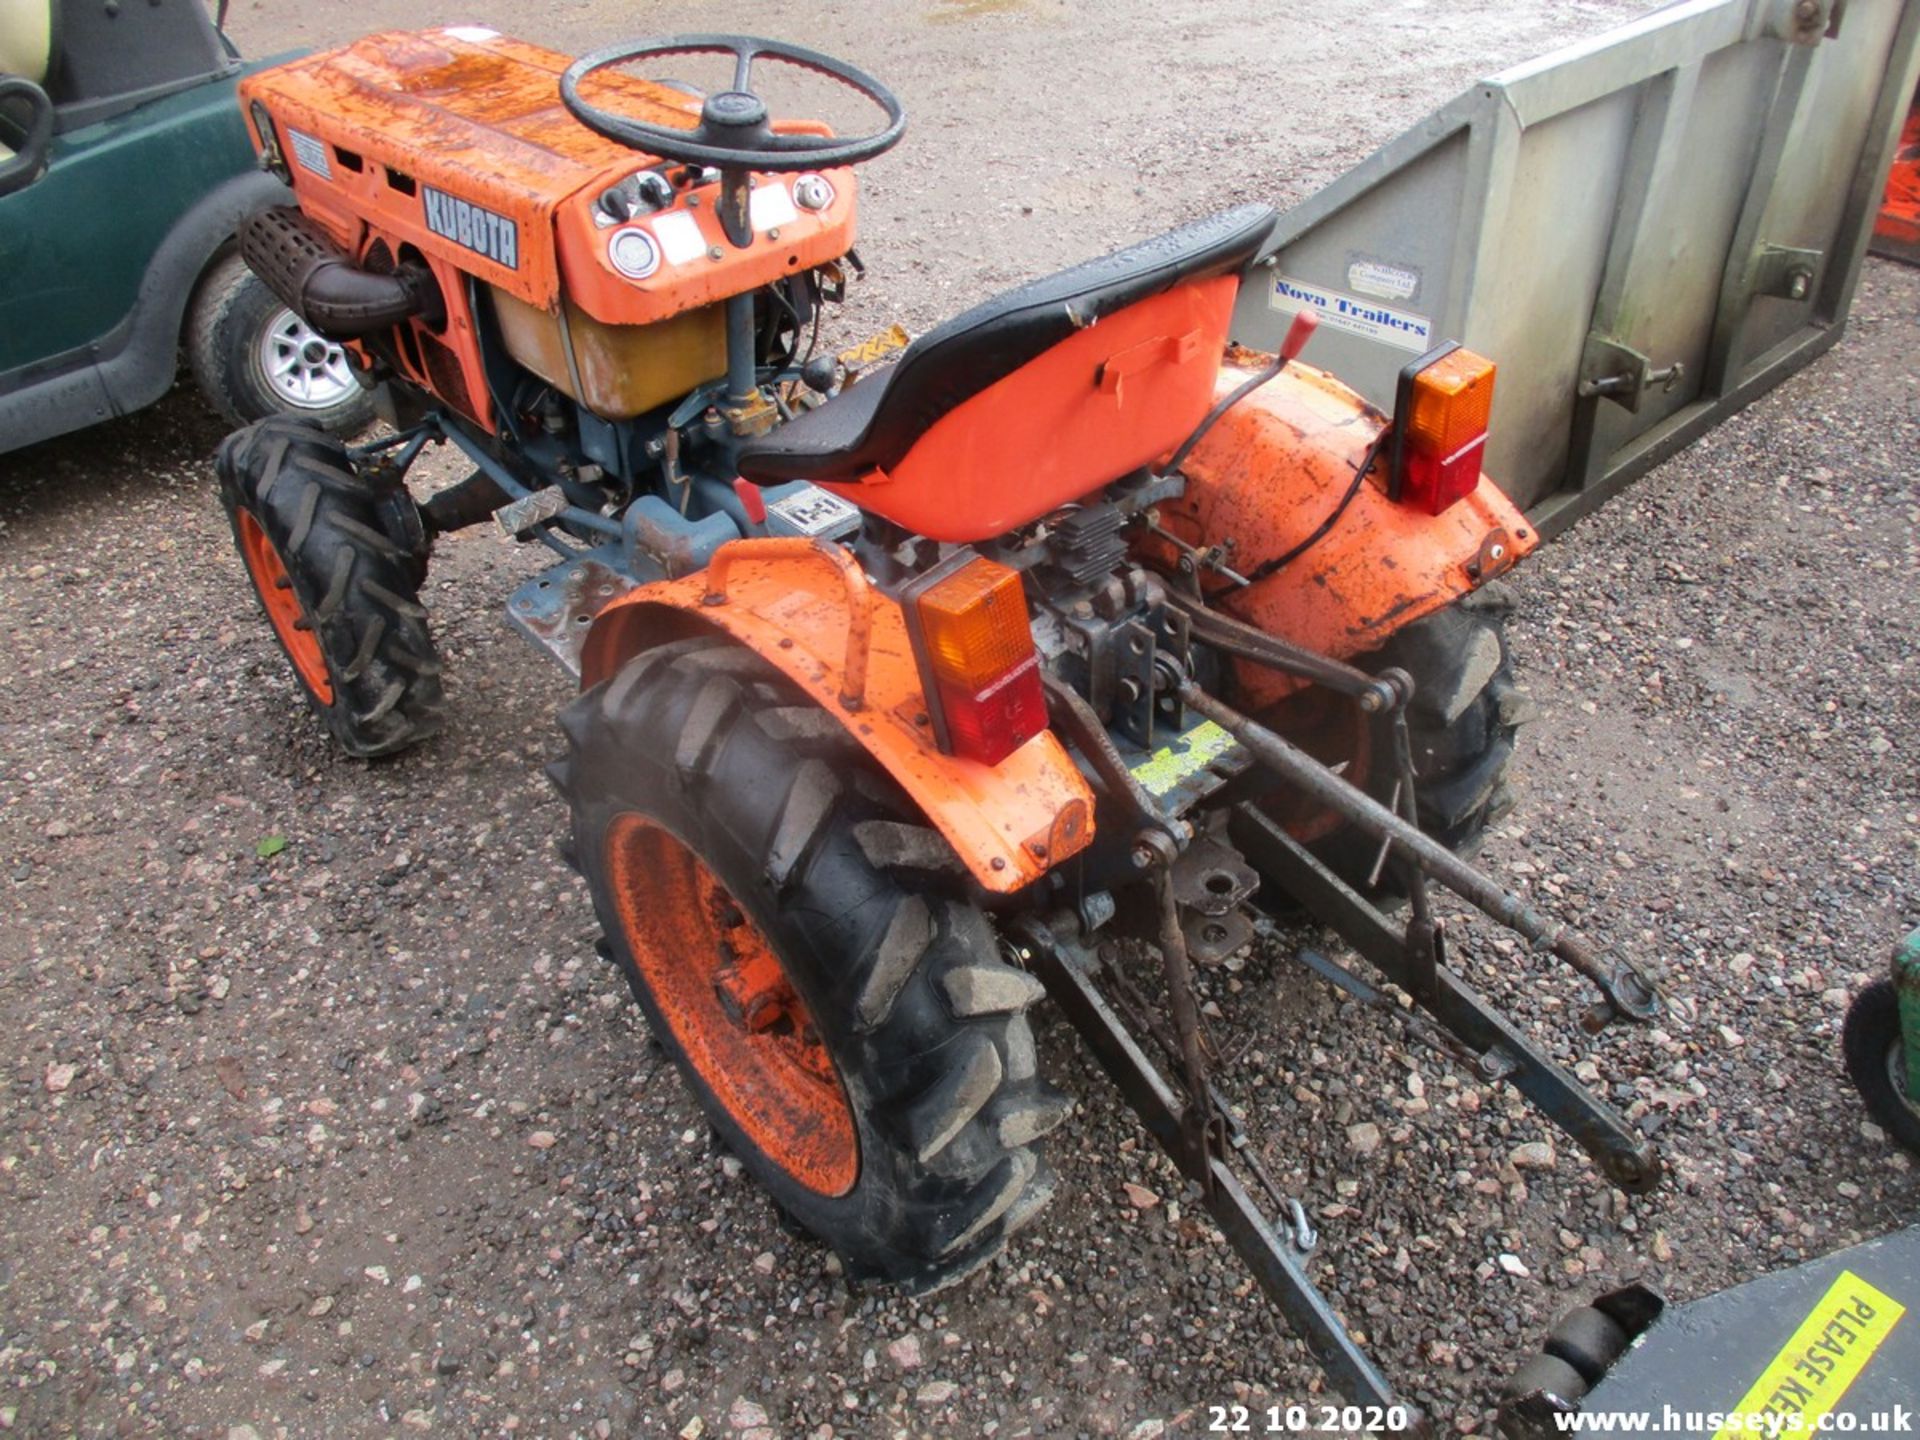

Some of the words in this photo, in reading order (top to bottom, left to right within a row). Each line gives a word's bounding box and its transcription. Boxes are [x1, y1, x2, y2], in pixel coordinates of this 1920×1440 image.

[423, 187, 517, 270] KUBOTA
[1275, 281, 1327, 307] Nova
[1335, 298, 1427, 337] Trailers
[1793, 1295, 1877, 1386] PLEASE
